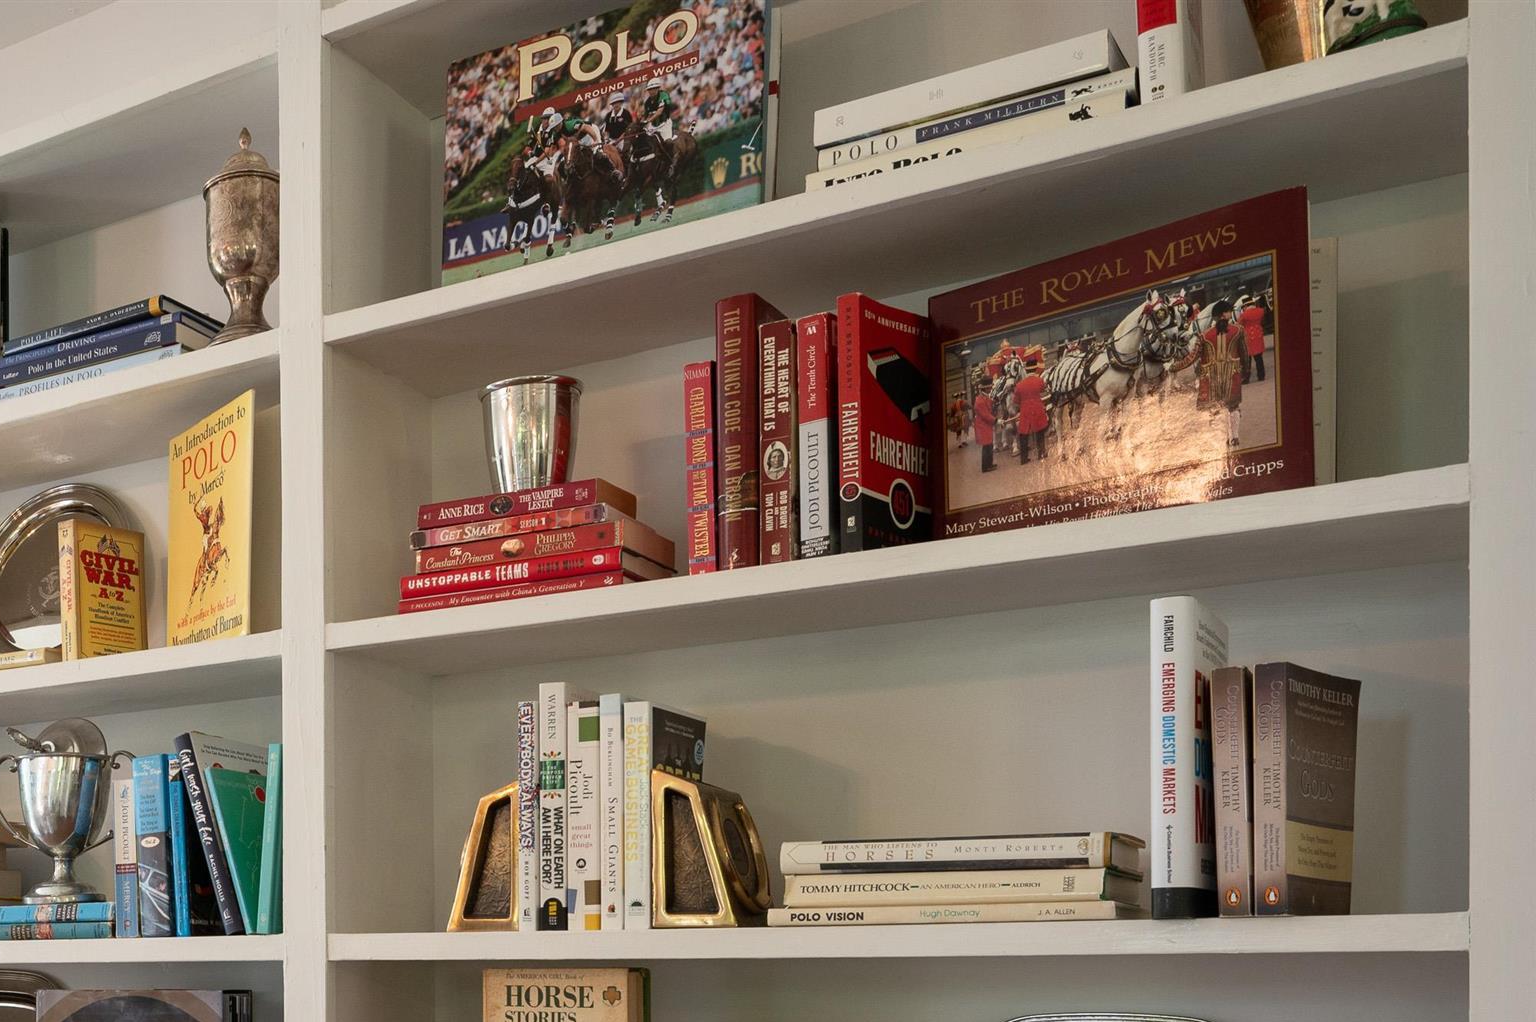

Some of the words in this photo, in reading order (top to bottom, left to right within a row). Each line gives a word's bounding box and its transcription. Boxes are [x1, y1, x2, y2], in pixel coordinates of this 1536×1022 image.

[516, 8, 700, 103] POLO
[574, 81, 625, 104] AROUND
[628, 74, 648, 87] THE
[652, 56, 698, 77] WORLD
[832, 134, 898, 165] POLO
[921, 115, 974, 138] FRANK
[984, 93, 1060, 121] MILBURN
[970, 287, 1025, 323] THE
[1040, 258, 1130, 306] ROYAL
[1144, 223, 1237, 274] MEWS
[723, 308, 741, 332] THE
[723, 337, 741, 355] DA
[777, 348, 789, 366] THE
[808, 345, 816, 369] Circle
[764, 336, 776, 393] EVERYTHING
[724, 359, 741, 397] VINCI
[777, 367, 789, 394] HEART
[808, 370, 816, 392] Tenth
[764, 394, 775, 420] THAT
[777, 396, 789, 413] OF
[808, 393, 816, 408] The
[724, 401, 741, 434] CODE
[764, 421, 775, 432] IS
[172, 443, 183, 461] An
[184, 411, 235, 455] Introduction
[236, 405, 245, 420] to
[842, 402, 859, 479] FAHRENHEIT
[181, 430, 237, 490] POLO
[725, 445, 741, 472] DAN
[808, 431, 820, 498] PICOULT
[519, 494, 532, 503] THE
[531, 487, 564, 501] VAMPIRE
[528, 499, 555, 511] LESTAT
[725, 476, 741, 522] BROWN
[438, 506, 463, 520] ANNE
[463, 503, 485, 517] RICE
[808, 501, 819, 531] JODI
[534, 540, 577, 556] GREGORY
[536, 530, 576, 545] PHILIPPA
[80, 550, 139, 576] CIVIL
[426, 557, 460, 569] Constant
[462, 552, 495, 567] Princess
[449, 546, 463, 557] The
[86, 567, 136, 592] WAR,
[1163, 614, 1174, 653] FAIRCHILD
[1162, 663, 1175, 713] EMERGING
[1288, 678, 1321, 702] TIMOTHY
[1322, 686, 1353, 707] KELLER
[547, 693, 556, 740] WARREN
[1161, 715, 1176, 765] DOMESTIC
[179, 749, 195, 773] Girl,
[569, 758, 583, 816] Picoult
[582, 773, 593, 800] Jodi
[1162, 767, 1176, 815] MARKETS
[553, 806, 563, 832] WHAT
[553, 833, 563, 848] ON
[825, 849, 935, 862] HORSES
[554, 850, 564, 890] EARTH
[122, 880, 130, 913] MERCY
[790, 912, 822, 922] POLO
[826, 911, 864, 922] VISION
[919, 909, 942, 919] Hugh
[944, 909, 980, 919] Dawnay
[505, 984, 594, 1009] HORSE
